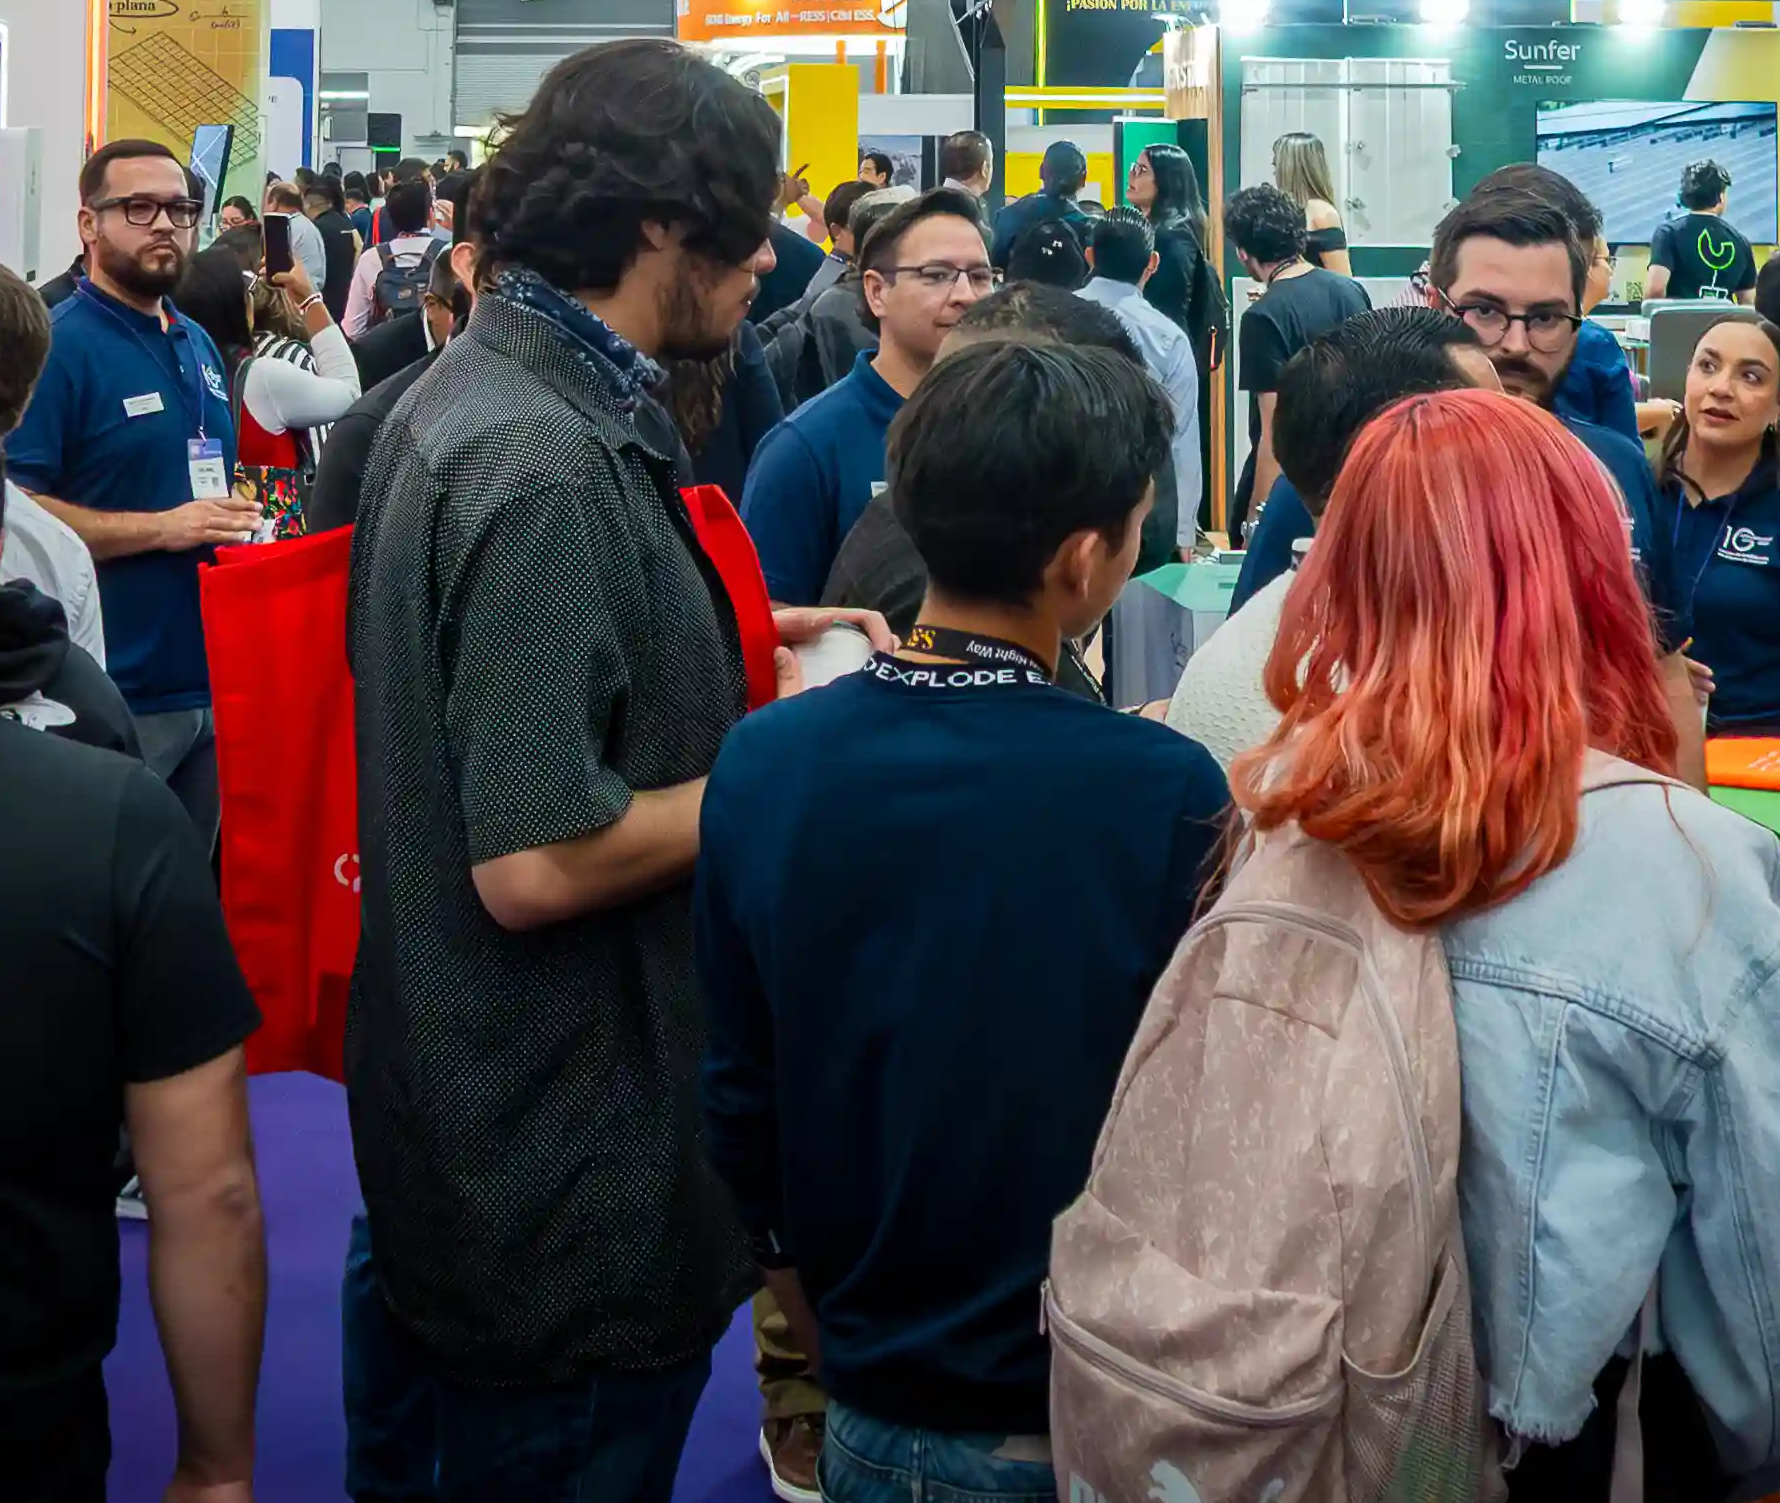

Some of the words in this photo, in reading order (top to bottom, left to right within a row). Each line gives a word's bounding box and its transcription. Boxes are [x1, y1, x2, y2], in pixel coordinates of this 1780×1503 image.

[116, 0, 156, 14] plana
[1151, 0, 1167, 11] LA
[756, 11, 772, 24] For
[1504, 39, 1581, 61] Sunfer
[1512, 75, 1543, 85] METAL
[1545, 75, 1573, 85] ROOF
[966, 639, 993, 659] Way
